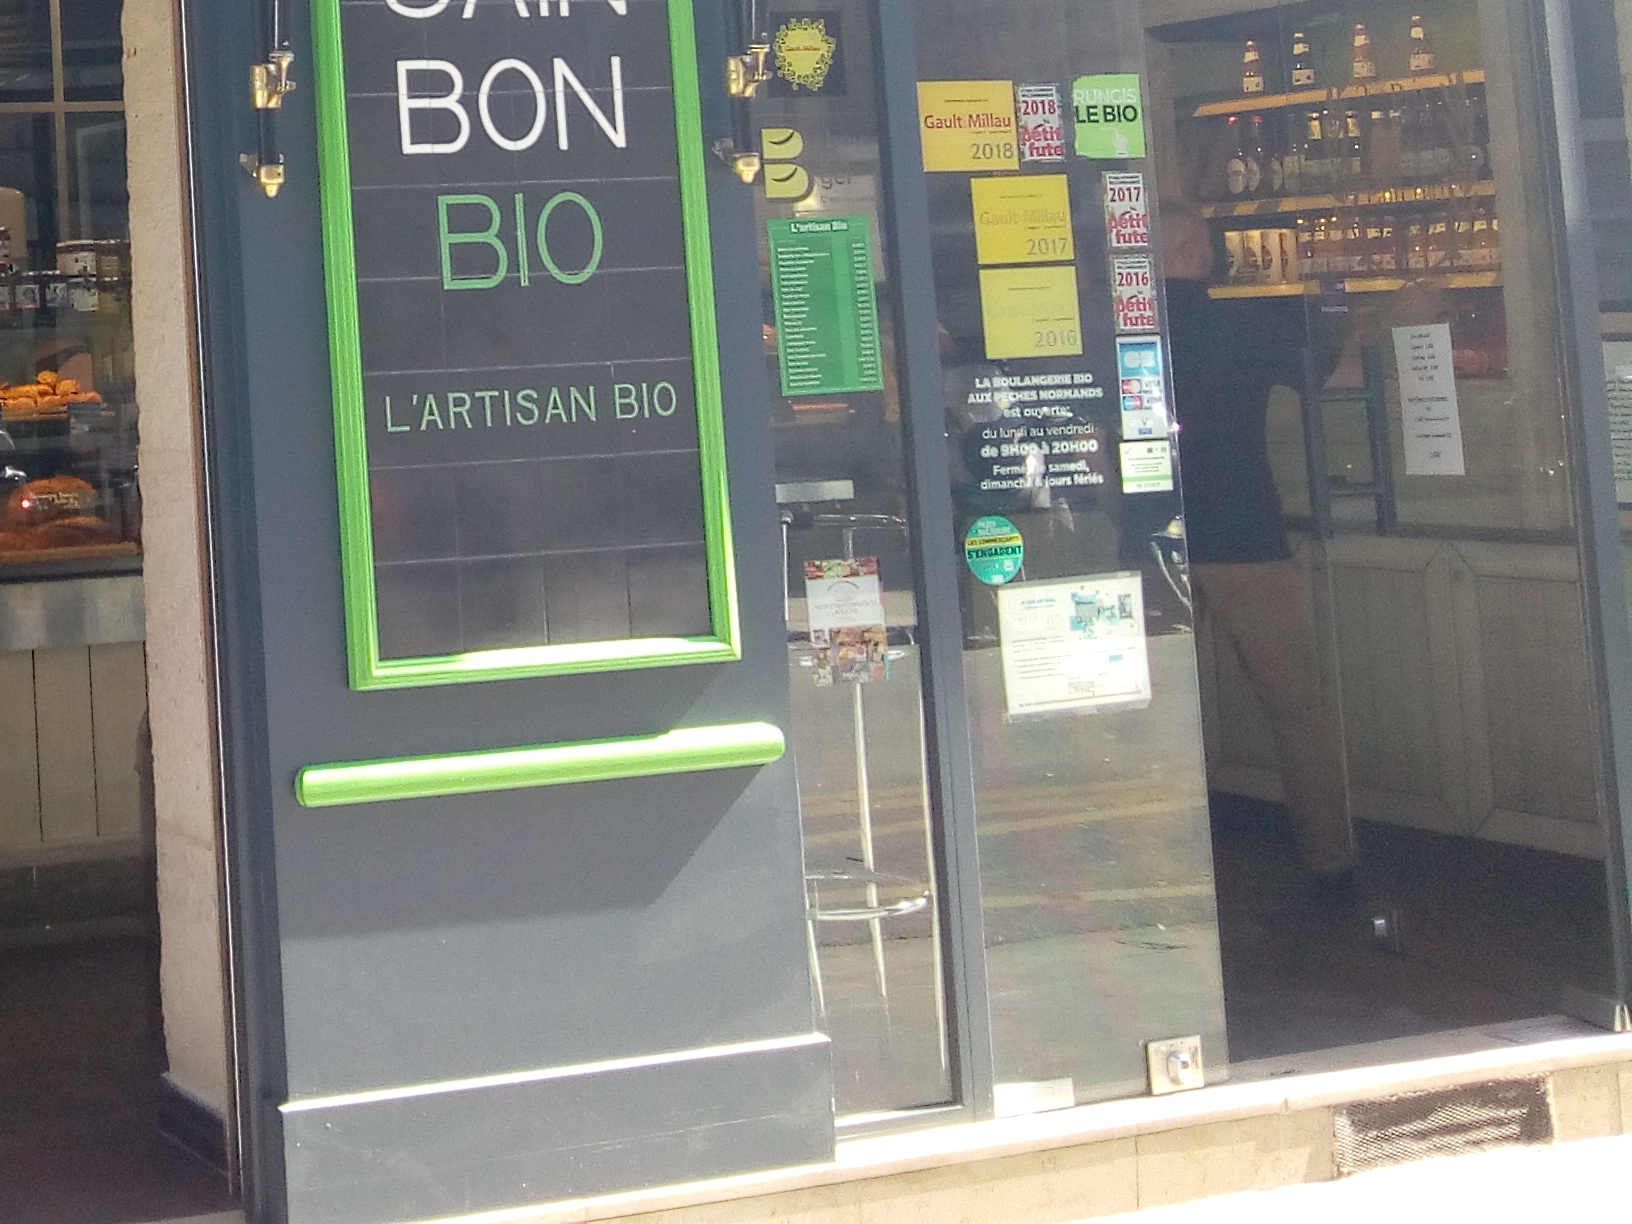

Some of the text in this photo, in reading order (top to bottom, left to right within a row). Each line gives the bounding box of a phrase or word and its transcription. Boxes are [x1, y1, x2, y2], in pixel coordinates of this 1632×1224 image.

[396, 55, 628, 155] BON
[1022, 99, 1056, 115] 2018
[1075, 104, 1138, 123] LE BIO
[971, 142, 1014, 160] 2018
[1109, 187, 1141, 202] 2017
[438, 191, 604, 290] BIO
[1026, 238, 1069, 256] 2017
[1117, 271, 1149, 287] 2016
[1035, 330, 1079, 348] 2016
[384, 380, 678, 433] L'ARTISAN BIO
[982, 428, 997, 439] du
[1029, 428, 1044, 436] au
[1046, 423, 1095, 436] vendredi
[980, 445, 999, 457] de
[1051, 439, 1098, 454] 20H00
